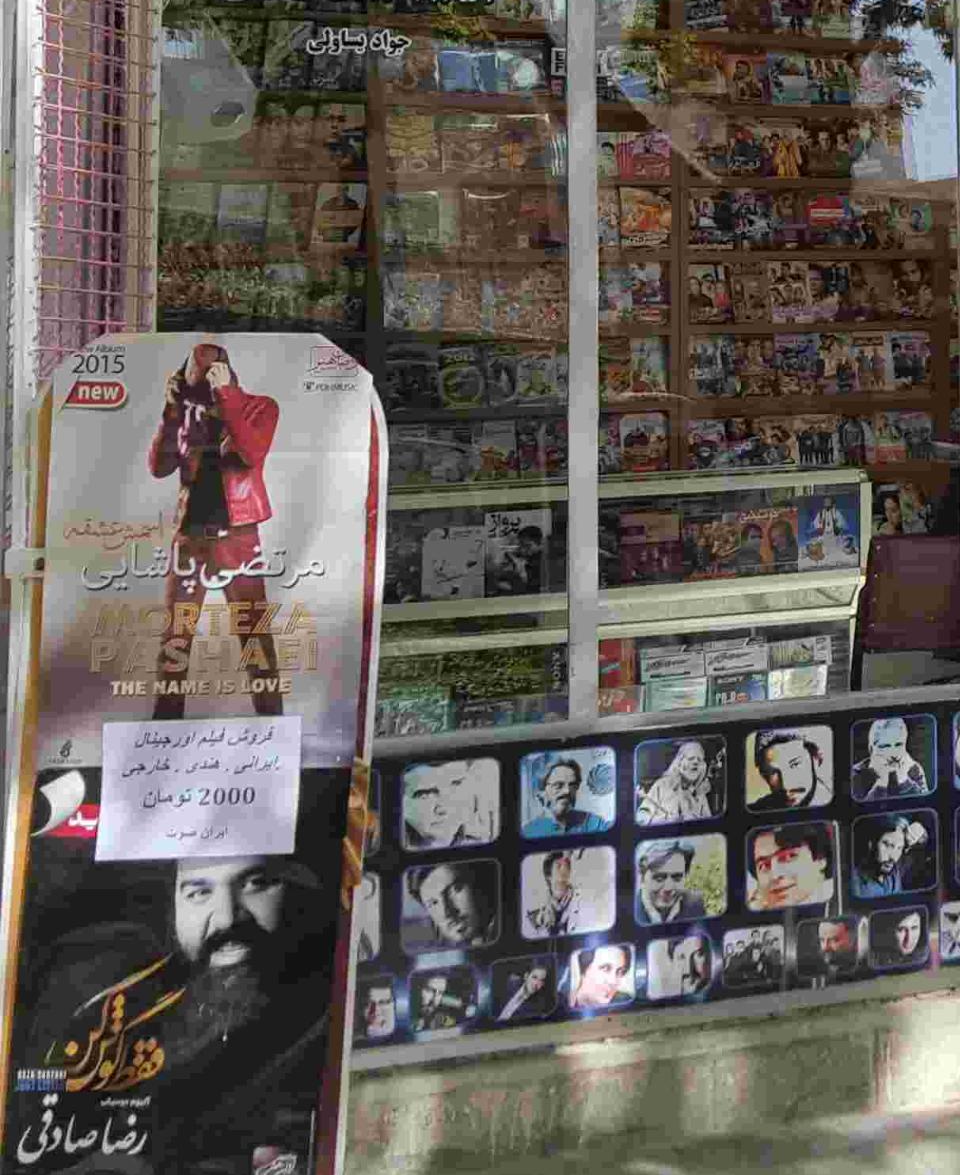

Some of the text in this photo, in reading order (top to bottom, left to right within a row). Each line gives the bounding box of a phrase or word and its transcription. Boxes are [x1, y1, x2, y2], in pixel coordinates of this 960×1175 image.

[369, 28, 413, 57] جواد
[72, 353, 125, 374] 2015
[78, 384, 120, 401] new
[81, 540, 329, 595] مرتضی پاشایی
[90, 601, 318, 636] MORTEZA
[89, 637, 319, 674] PASHAEI
[111, 677, 293, 697] THE NAME IS LOVE
[134, 725, 276, 749] فروش فیلم اورجینال
[121, 758, 171, 778] خارجی
[142, 786, 256, 809] 2000 تومان
[200, 826, 229, 840] ایران
[17, 1092, 148, 1165] رضا صادقی
